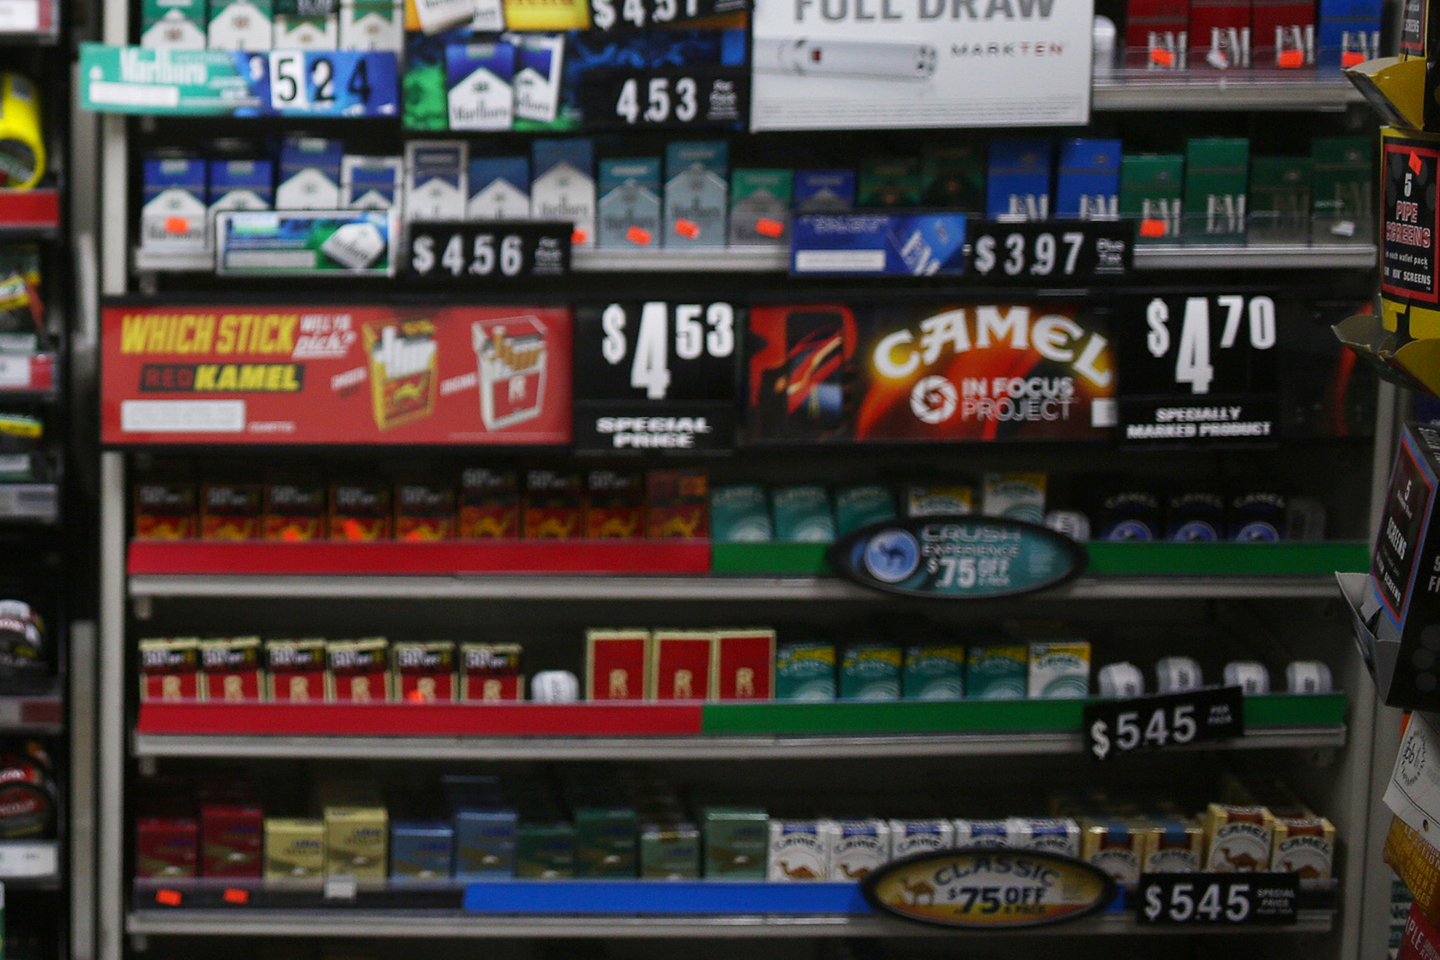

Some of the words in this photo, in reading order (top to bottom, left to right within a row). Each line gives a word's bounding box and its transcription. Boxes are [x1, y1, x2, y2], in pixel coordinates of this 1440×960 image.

[950, 42, 1064, 57] MARKTEN
[1404, 172, 1413, 197] 5
[1396, 200, 1419, 223] PIPE
[1386, 221, 1431, 248] SCREENS
[1403, 271, 1431, 286] SCREENS
[122, 313, 216, 355] WHICH
[215, 313, 300, 355] STICK
[873, 304, 1115, 388] CAMEL
[193, 363, 302, 391] KAMEL
[961, 378, 988, 397] IN
[993, 377, 1074, 397] FOCUS
[961, 398, 1074, 421] PROJECT
[1155, 406, 1242, 423] SPECIALLY
[596, 417, 712, 434] SPECIAL
[1127, 422, 1196, 439] MARKED
[1199, 421, 1271, 438] PRODUCT
[613, 433, 695, 448] PRICE
[933, 853, 1061, 890] CLASSIC
[1002, 885, 1046, 904] OFF
